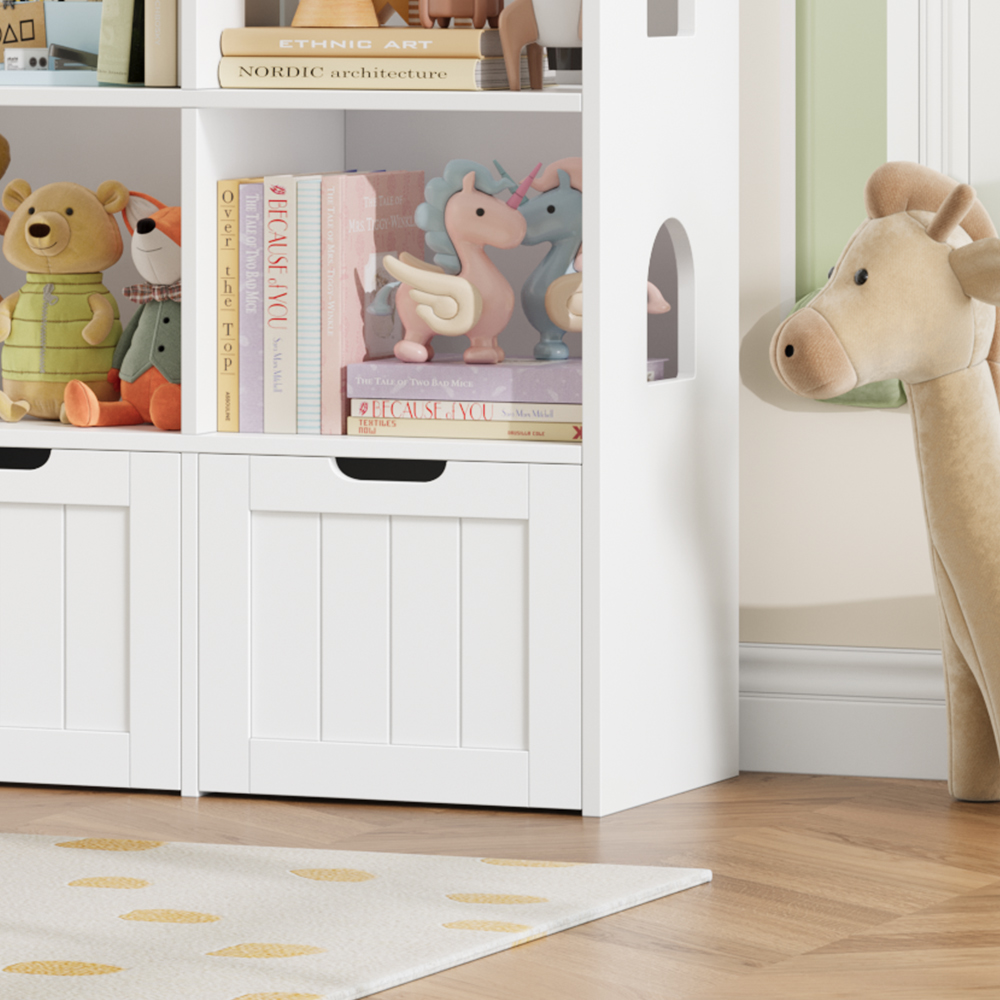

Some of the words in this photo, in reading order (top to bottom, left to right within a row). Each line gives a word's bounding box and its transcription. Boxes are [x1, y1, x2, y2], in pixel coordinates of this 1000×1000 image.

[279, 38, 372, 49] ETHNIC
[383, 40, 433, 49] ART
[238, 65, 324, 79] NORDIC
[330, 66, 448, 80] architecture
[245, 193, 259, 212] THE
[326, 186, 336, 205] THE
[378, 195, 394, 207] TALE
[245, 213, 259, 235] TALE
[326, 206, 336, 229] TALE
[268, 199, 288, 274] BECAUSE
[245, 249, 259, 270] TWO
[221, 266, 235, 309] the
[245, 271, 259, 289] BAD
[268, 278, 288, 289] of
[245, 290, 259, 314] MICE
[268, 292, 288, 329] YOU
[355, 376, 373, 386] THE
[374, 377, 396, 386] TALE
[397, 378, 408, 386] OF
[410, 379, 430, 387] TWO
[431, 379, 450, 388] BAD
[451, 380, 474, 388] MICE
[372, 400, 442, 420] BECAUSE
[445, 402, 456, 420] of
[459, 402, 494, 421] YOU
[358, 419, 397, 427] TEXTILES
